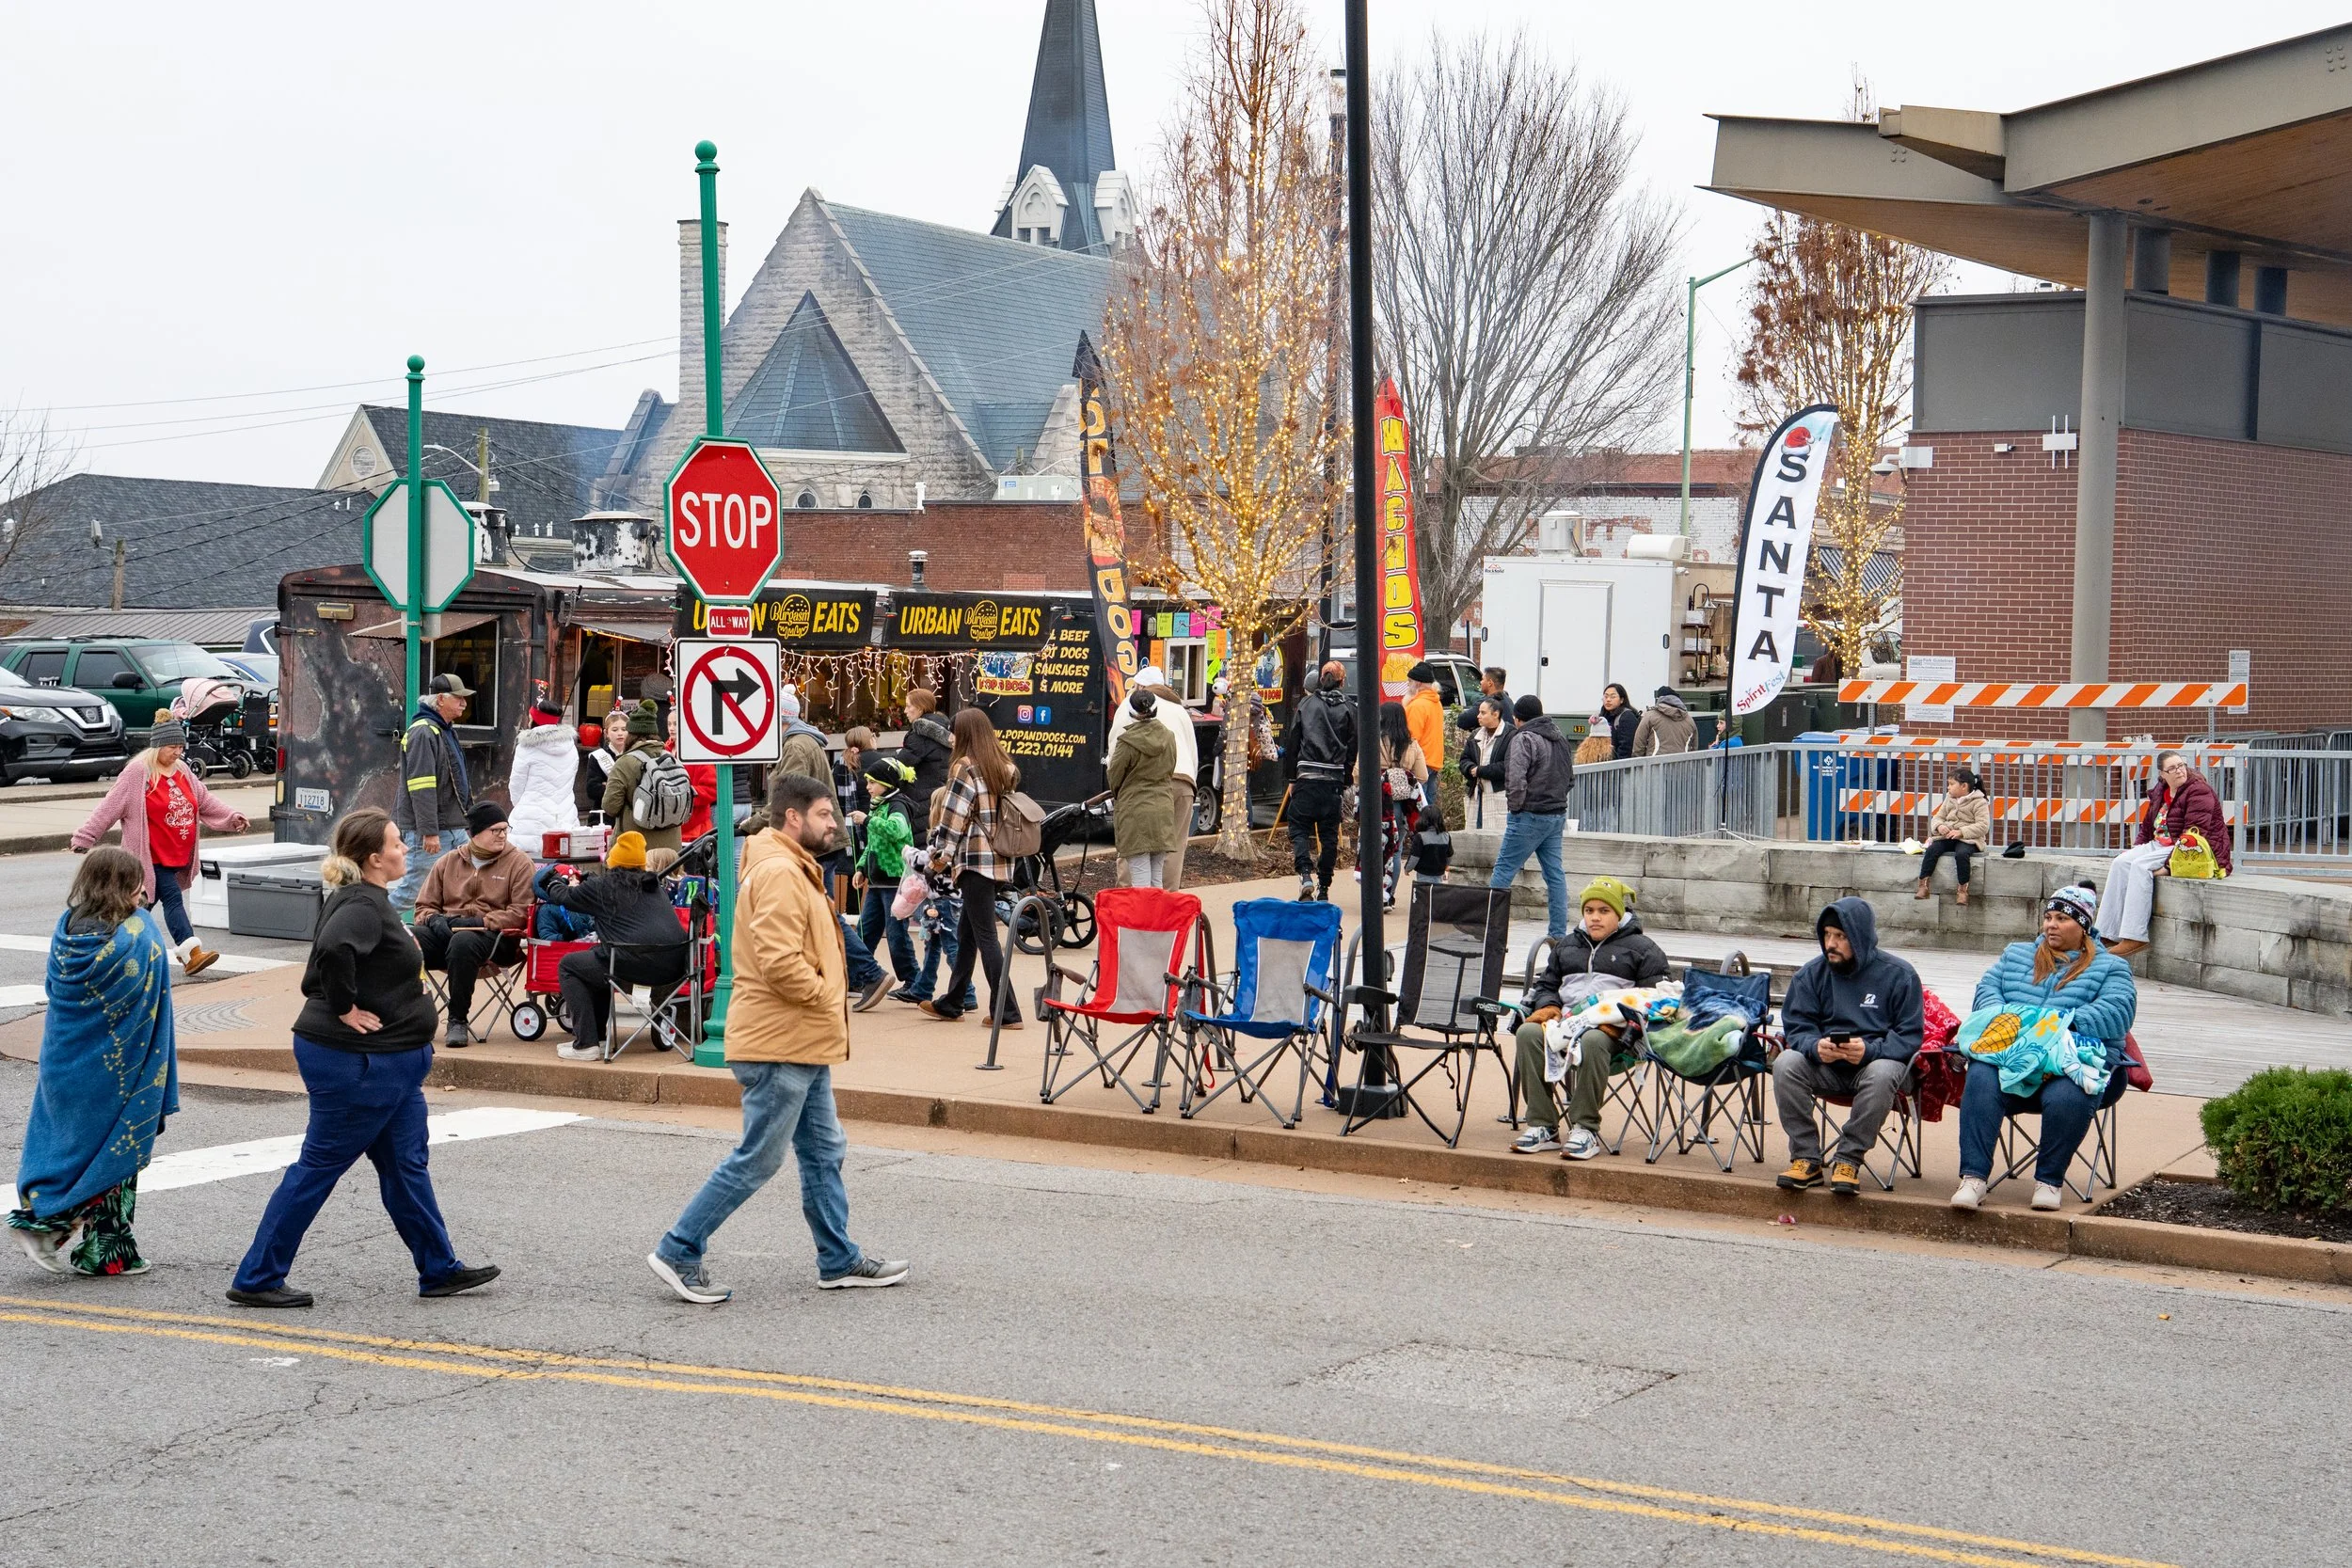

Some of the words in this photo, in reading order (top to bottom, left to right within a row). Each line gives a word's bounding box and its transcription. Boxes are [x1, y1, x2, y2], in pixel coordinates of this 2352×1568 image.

[679, 491, 772, 549] STOP
[1380, 417, 1419, 649] NACHOS
[1748, 453, 1810, 664] SANTA
[710, 616, 726, 628] ALL
[732, 616, 749, 629] WAY
[812, 602, 861, 633] EATS
[899, 606, 962, 635] URBAN
[999, 607, 1041, 636] EATS
[1059, 629, 1090, 641] BEEF
[1060, 647, 1089, 659] DOGS
[1035, 662, 1090, 677] SAUSAGES
[1040, 679, 1048, 692] &
[1050, 681, 1085, 693] MORE
[1737, 670, 1786, 711] SpiritFest
[993, 729, 1087, 743] W.POPANDDOGS.COM
[998, 739, 1073, 758] 31.223.0144
[300, 794, 325, 806] 112718
